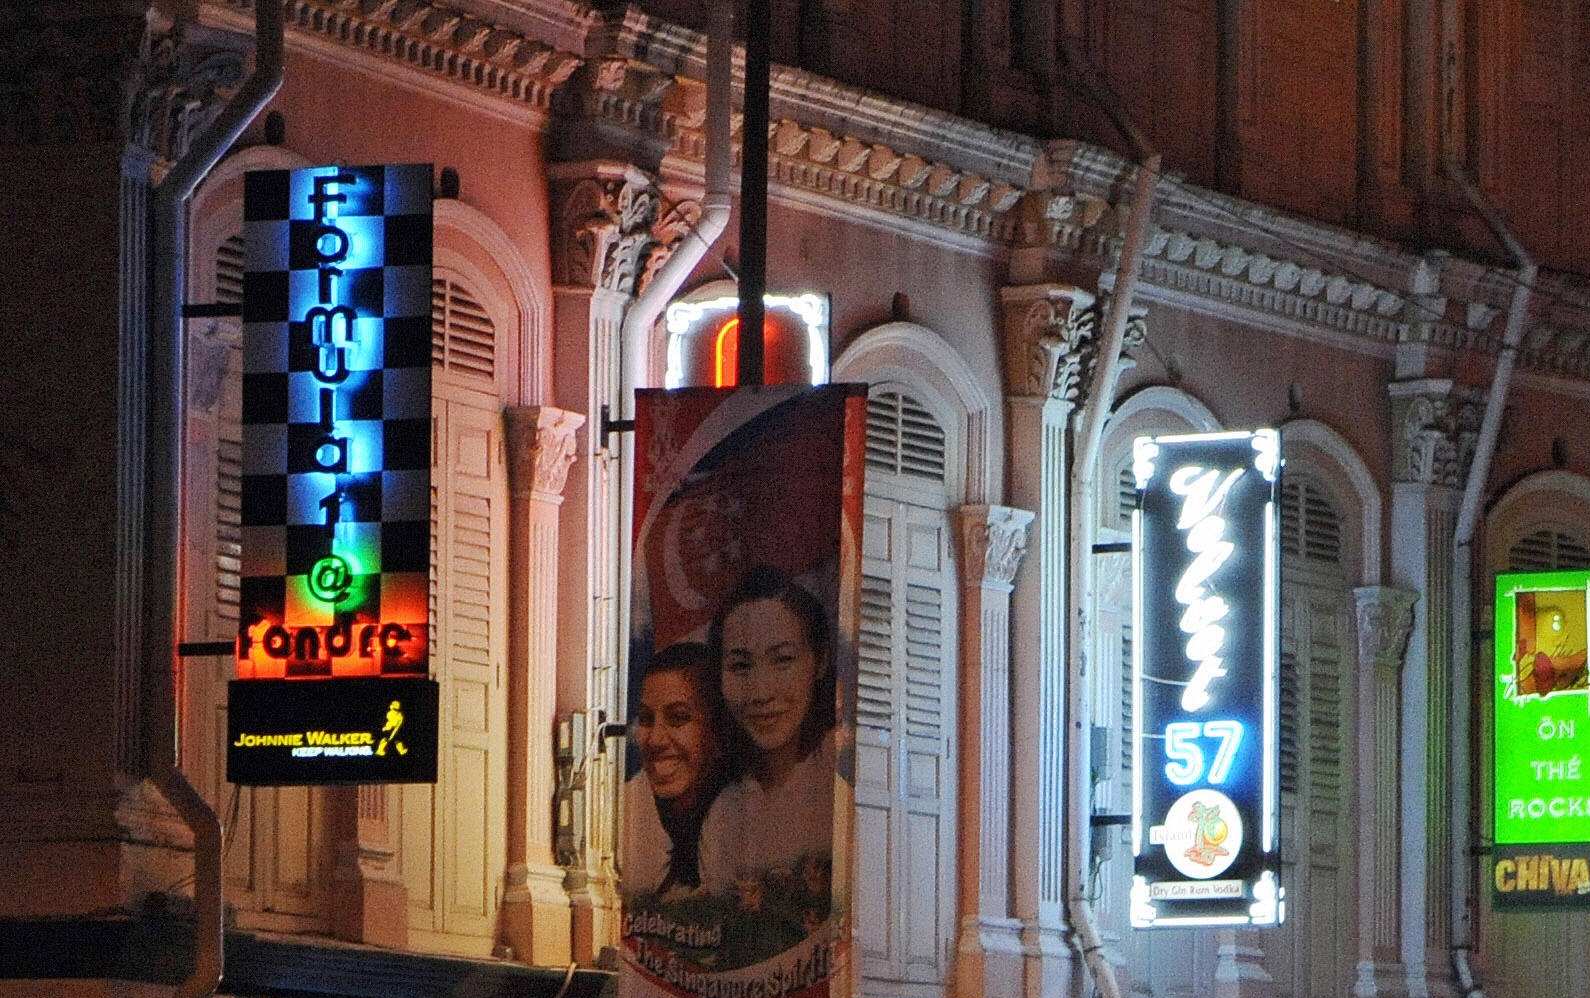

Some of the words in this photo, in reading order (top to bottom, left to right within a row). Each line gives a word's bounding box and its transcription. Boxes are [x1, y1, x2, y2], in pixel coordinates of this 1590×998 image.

[234, 733, 303, 747] JOHNNIE
[1164, 720, 1244, 785] 57
[1213, 883, 1240, 894] Vodka
